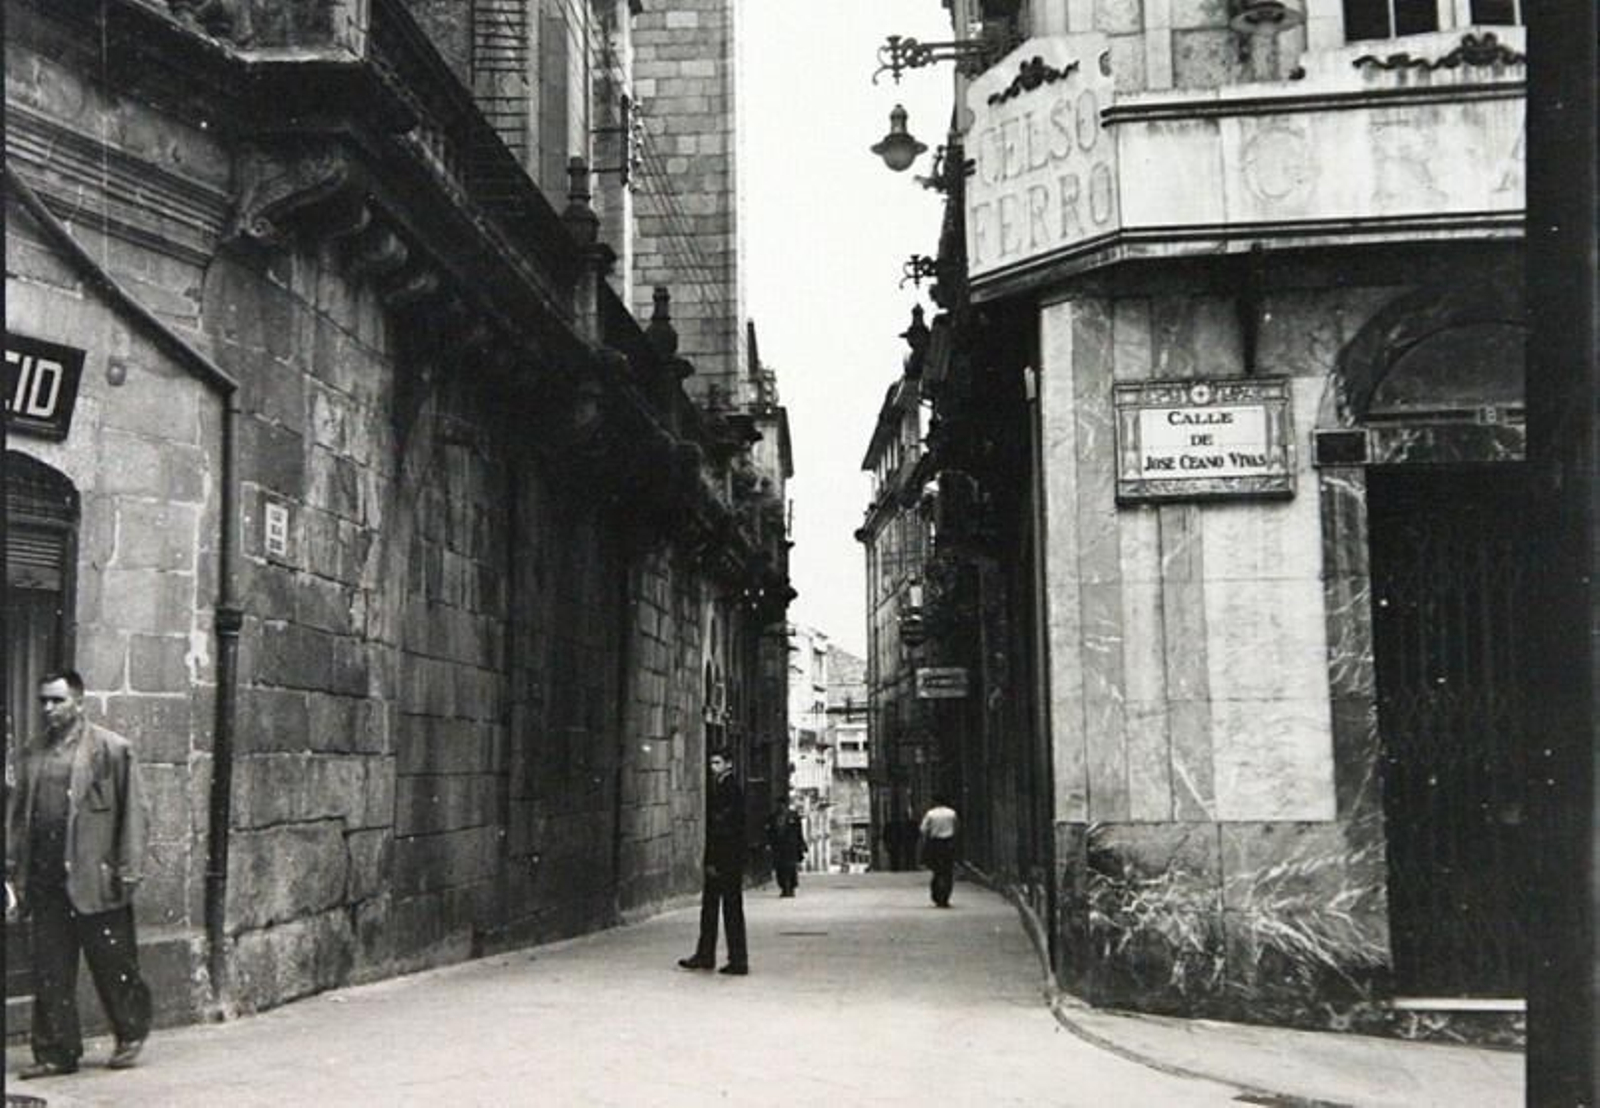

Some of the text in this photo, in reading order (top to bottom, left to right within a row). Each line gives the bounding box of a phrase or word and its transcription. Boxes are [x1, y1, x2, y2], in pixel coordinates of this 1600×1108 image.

[978, 88, 1098, 187] CELSO
[970, 162, 1113, 266] FERRO
[1167, 411, 1234, 426] CALLE
[1190, 434, 1214, 446] DE
[1180, 454, 1225, 470] CEANO
